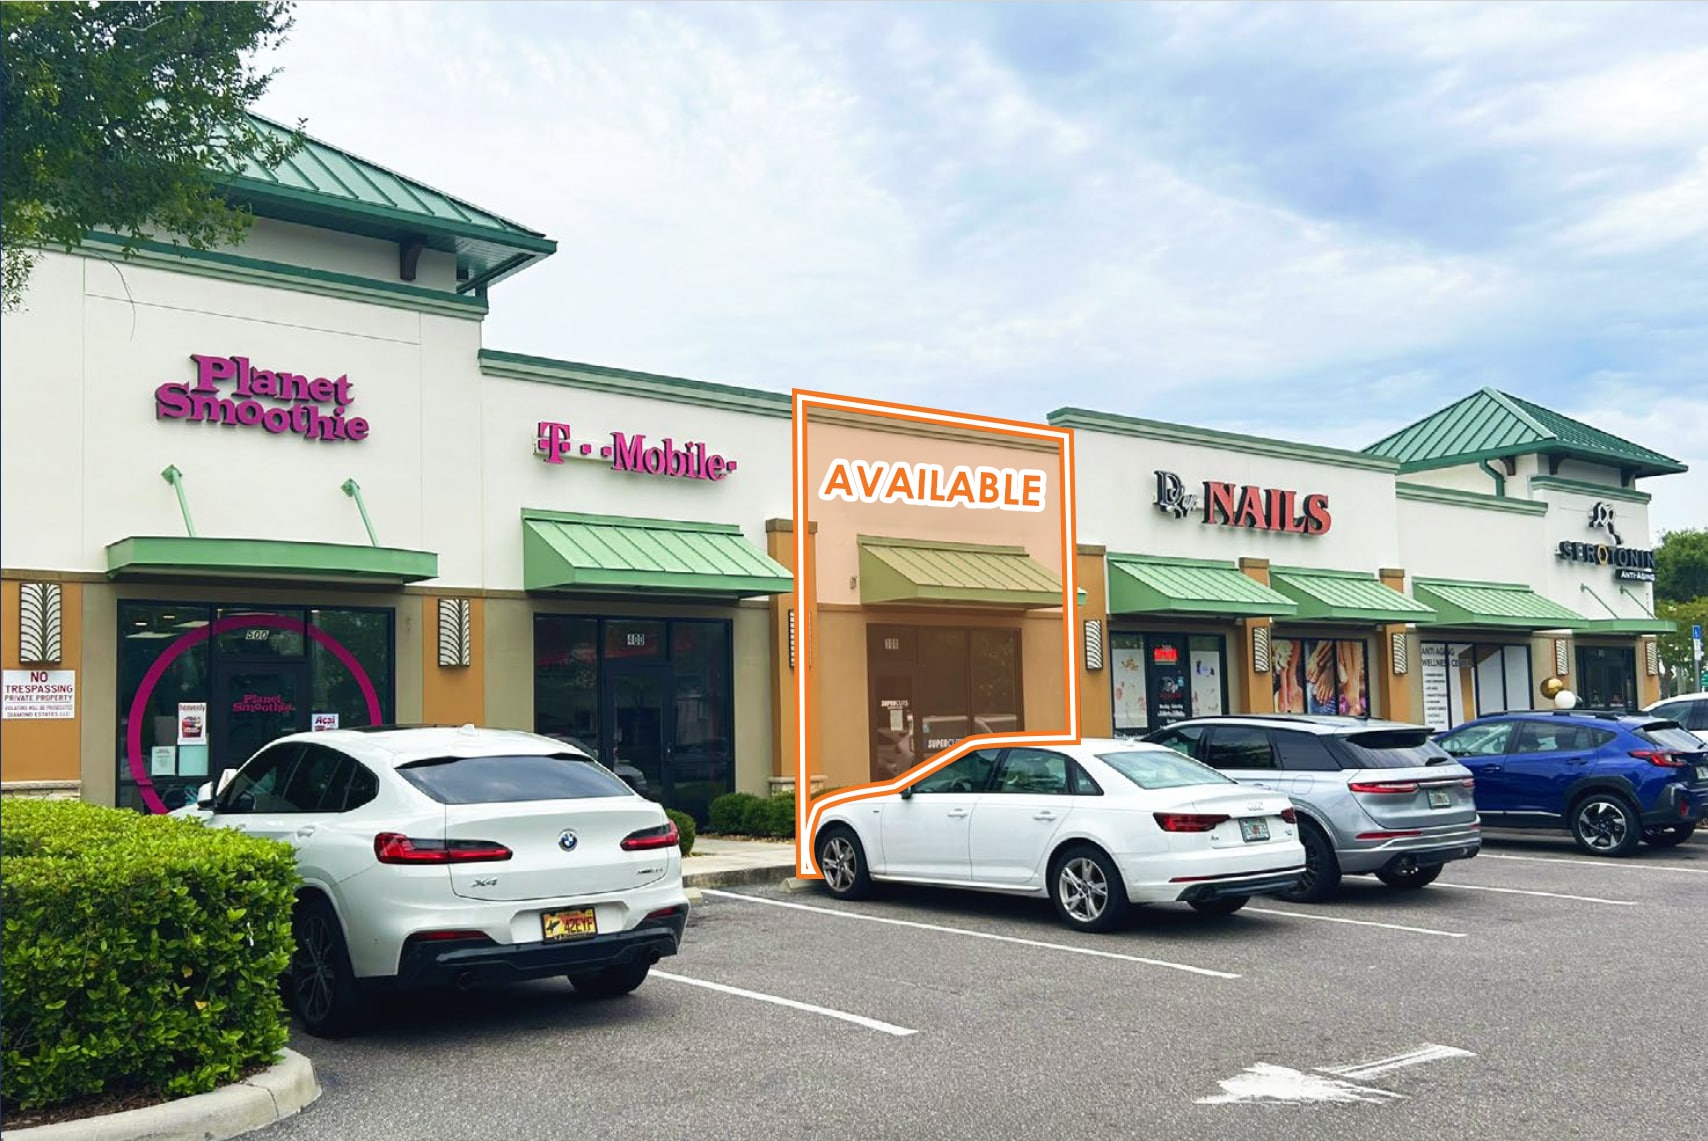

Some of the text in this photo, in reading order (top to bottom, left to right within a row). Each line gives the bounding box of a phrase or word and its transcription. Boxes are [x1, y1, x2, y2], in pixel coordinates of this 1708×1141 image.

[190, 353, 355, 406] Planet
[155, 381, 370, 440] Smoothie
[1202, 481, 1332, 536] NAILS
[1559, 541, 1655, 568] SEROTONIN
[246, 629, 270, 640] 500
[31, 671, 48, 682] NO
[6, 685, 73, 693] TRESPASSING
[927, 738, 962, 749] SUPERCU
